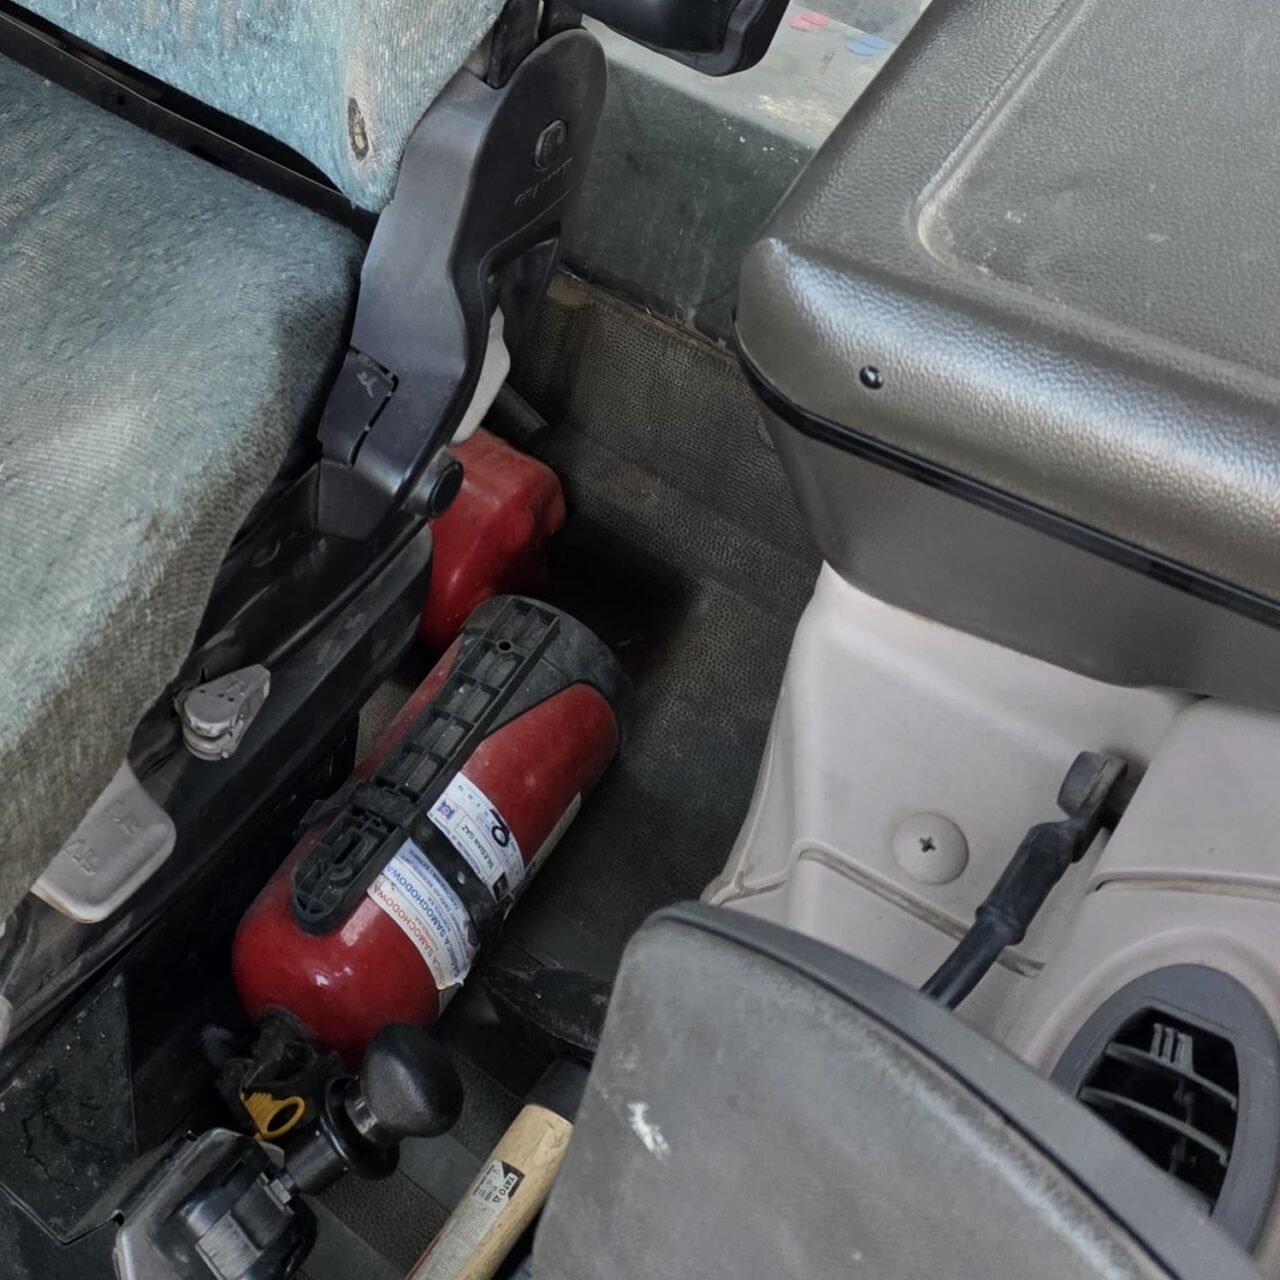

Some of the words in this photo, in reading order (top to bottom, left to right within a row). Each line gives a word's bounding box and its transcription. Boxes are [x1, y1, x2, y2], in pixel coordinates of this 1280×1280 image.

[461, 824, 475, 839] GAZ
[372, 883, 435, 957] SAMOCHODOWA
[387, 864, 445, 937] SAMOCHODOWA
[499, 1176, 515, 1196] YATO
